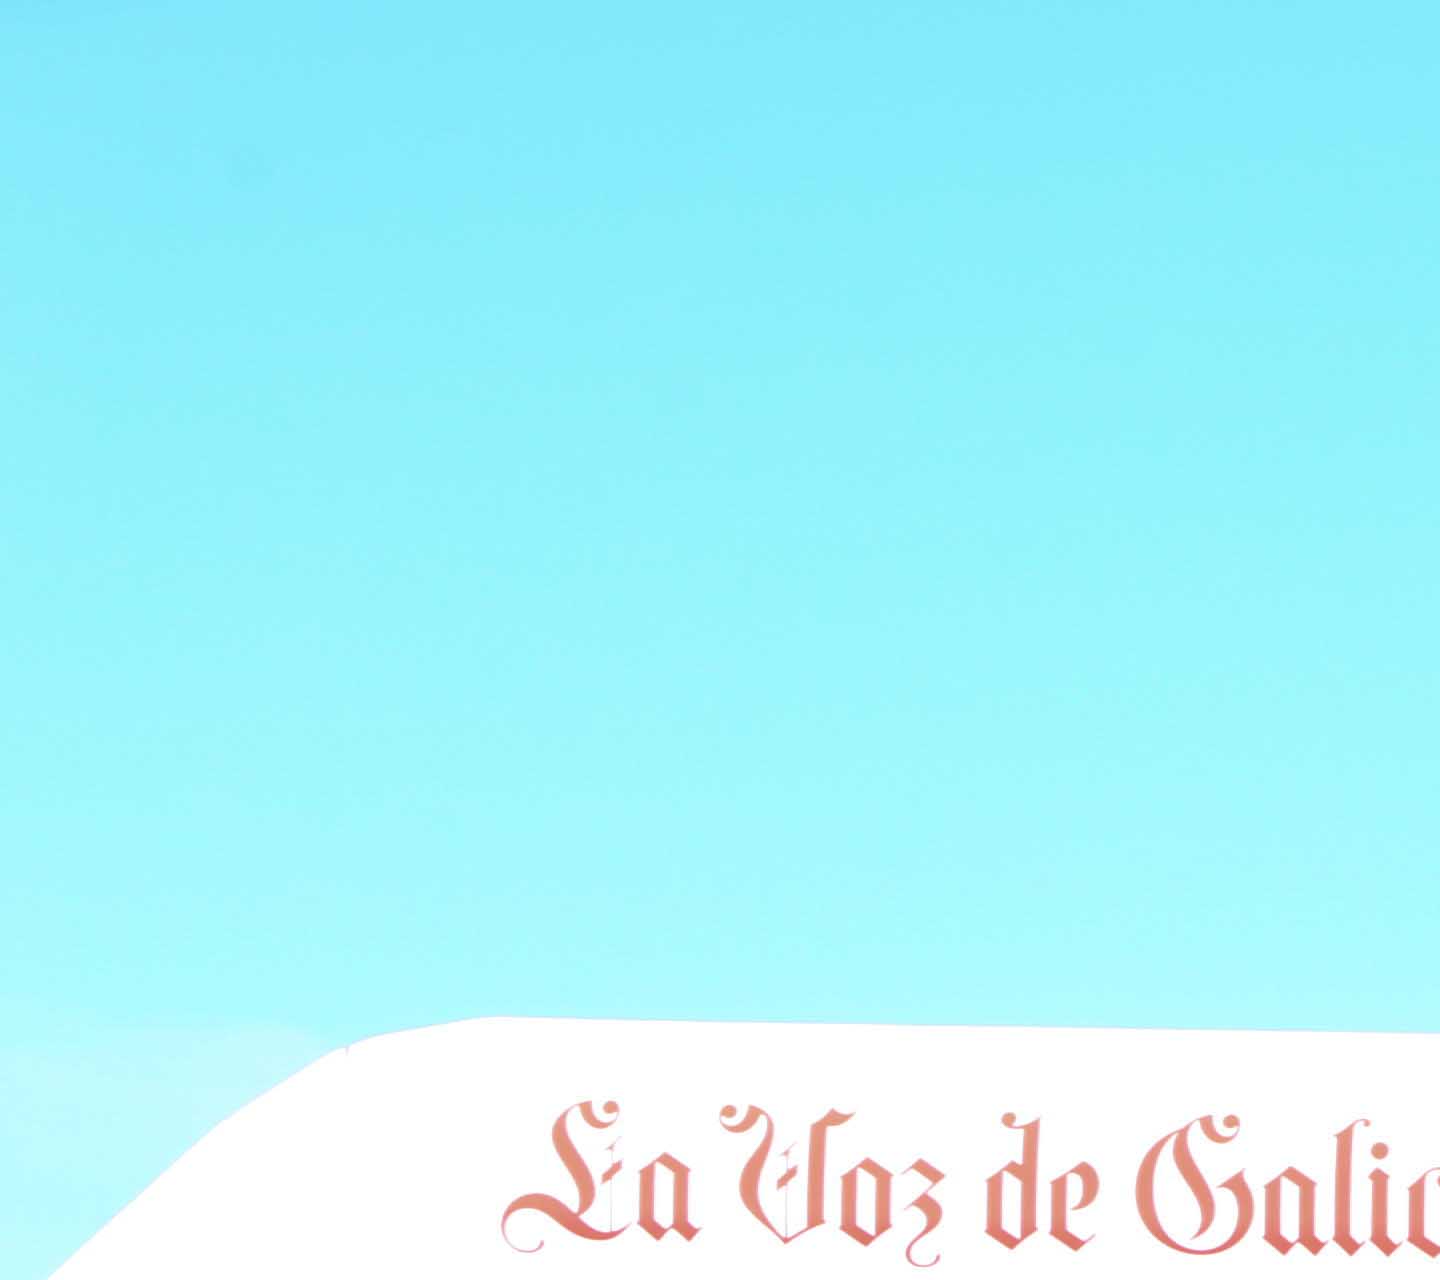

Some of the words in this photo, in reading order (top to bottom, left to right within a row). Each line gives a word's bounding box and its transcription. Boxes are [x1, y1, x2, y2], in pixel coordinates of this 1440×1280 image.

[501, 1099, 703, 1253] La
[718, 1104, 947, 1268] Voz
[984, 1111, 1100, 1251] de
